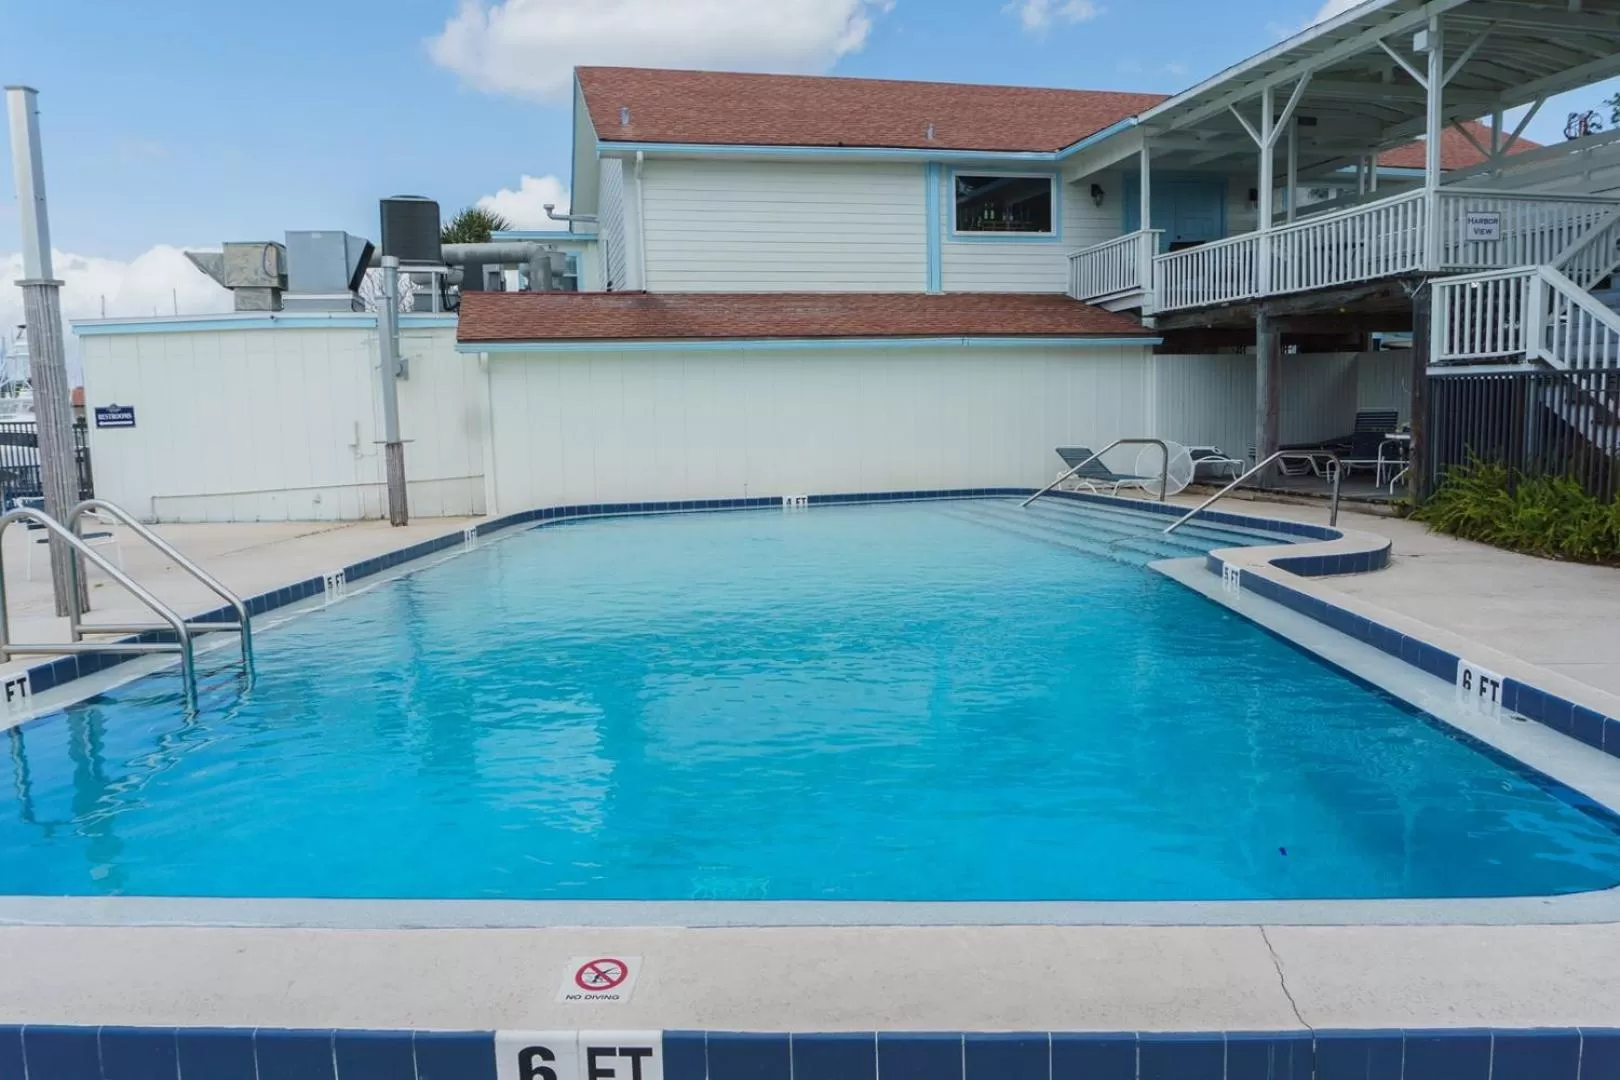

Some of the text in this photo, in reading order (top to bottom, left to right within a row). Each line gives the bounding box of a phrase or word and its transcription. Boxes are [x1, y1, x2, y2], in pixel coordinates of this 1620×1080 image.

[1473, 227, 1494, 235] VIEW
[97, 413, 133, 421] RESTROOMS
[795, 497, 807, 506] FT
[335, 572, 344, 587] FT
[1230, 569, 1239, 585] FT
[5, 677, 27, 702] FT
[1462, 668, 1500, 702] 6 FT
[518, 1045, 653, 1080] 6 FT
